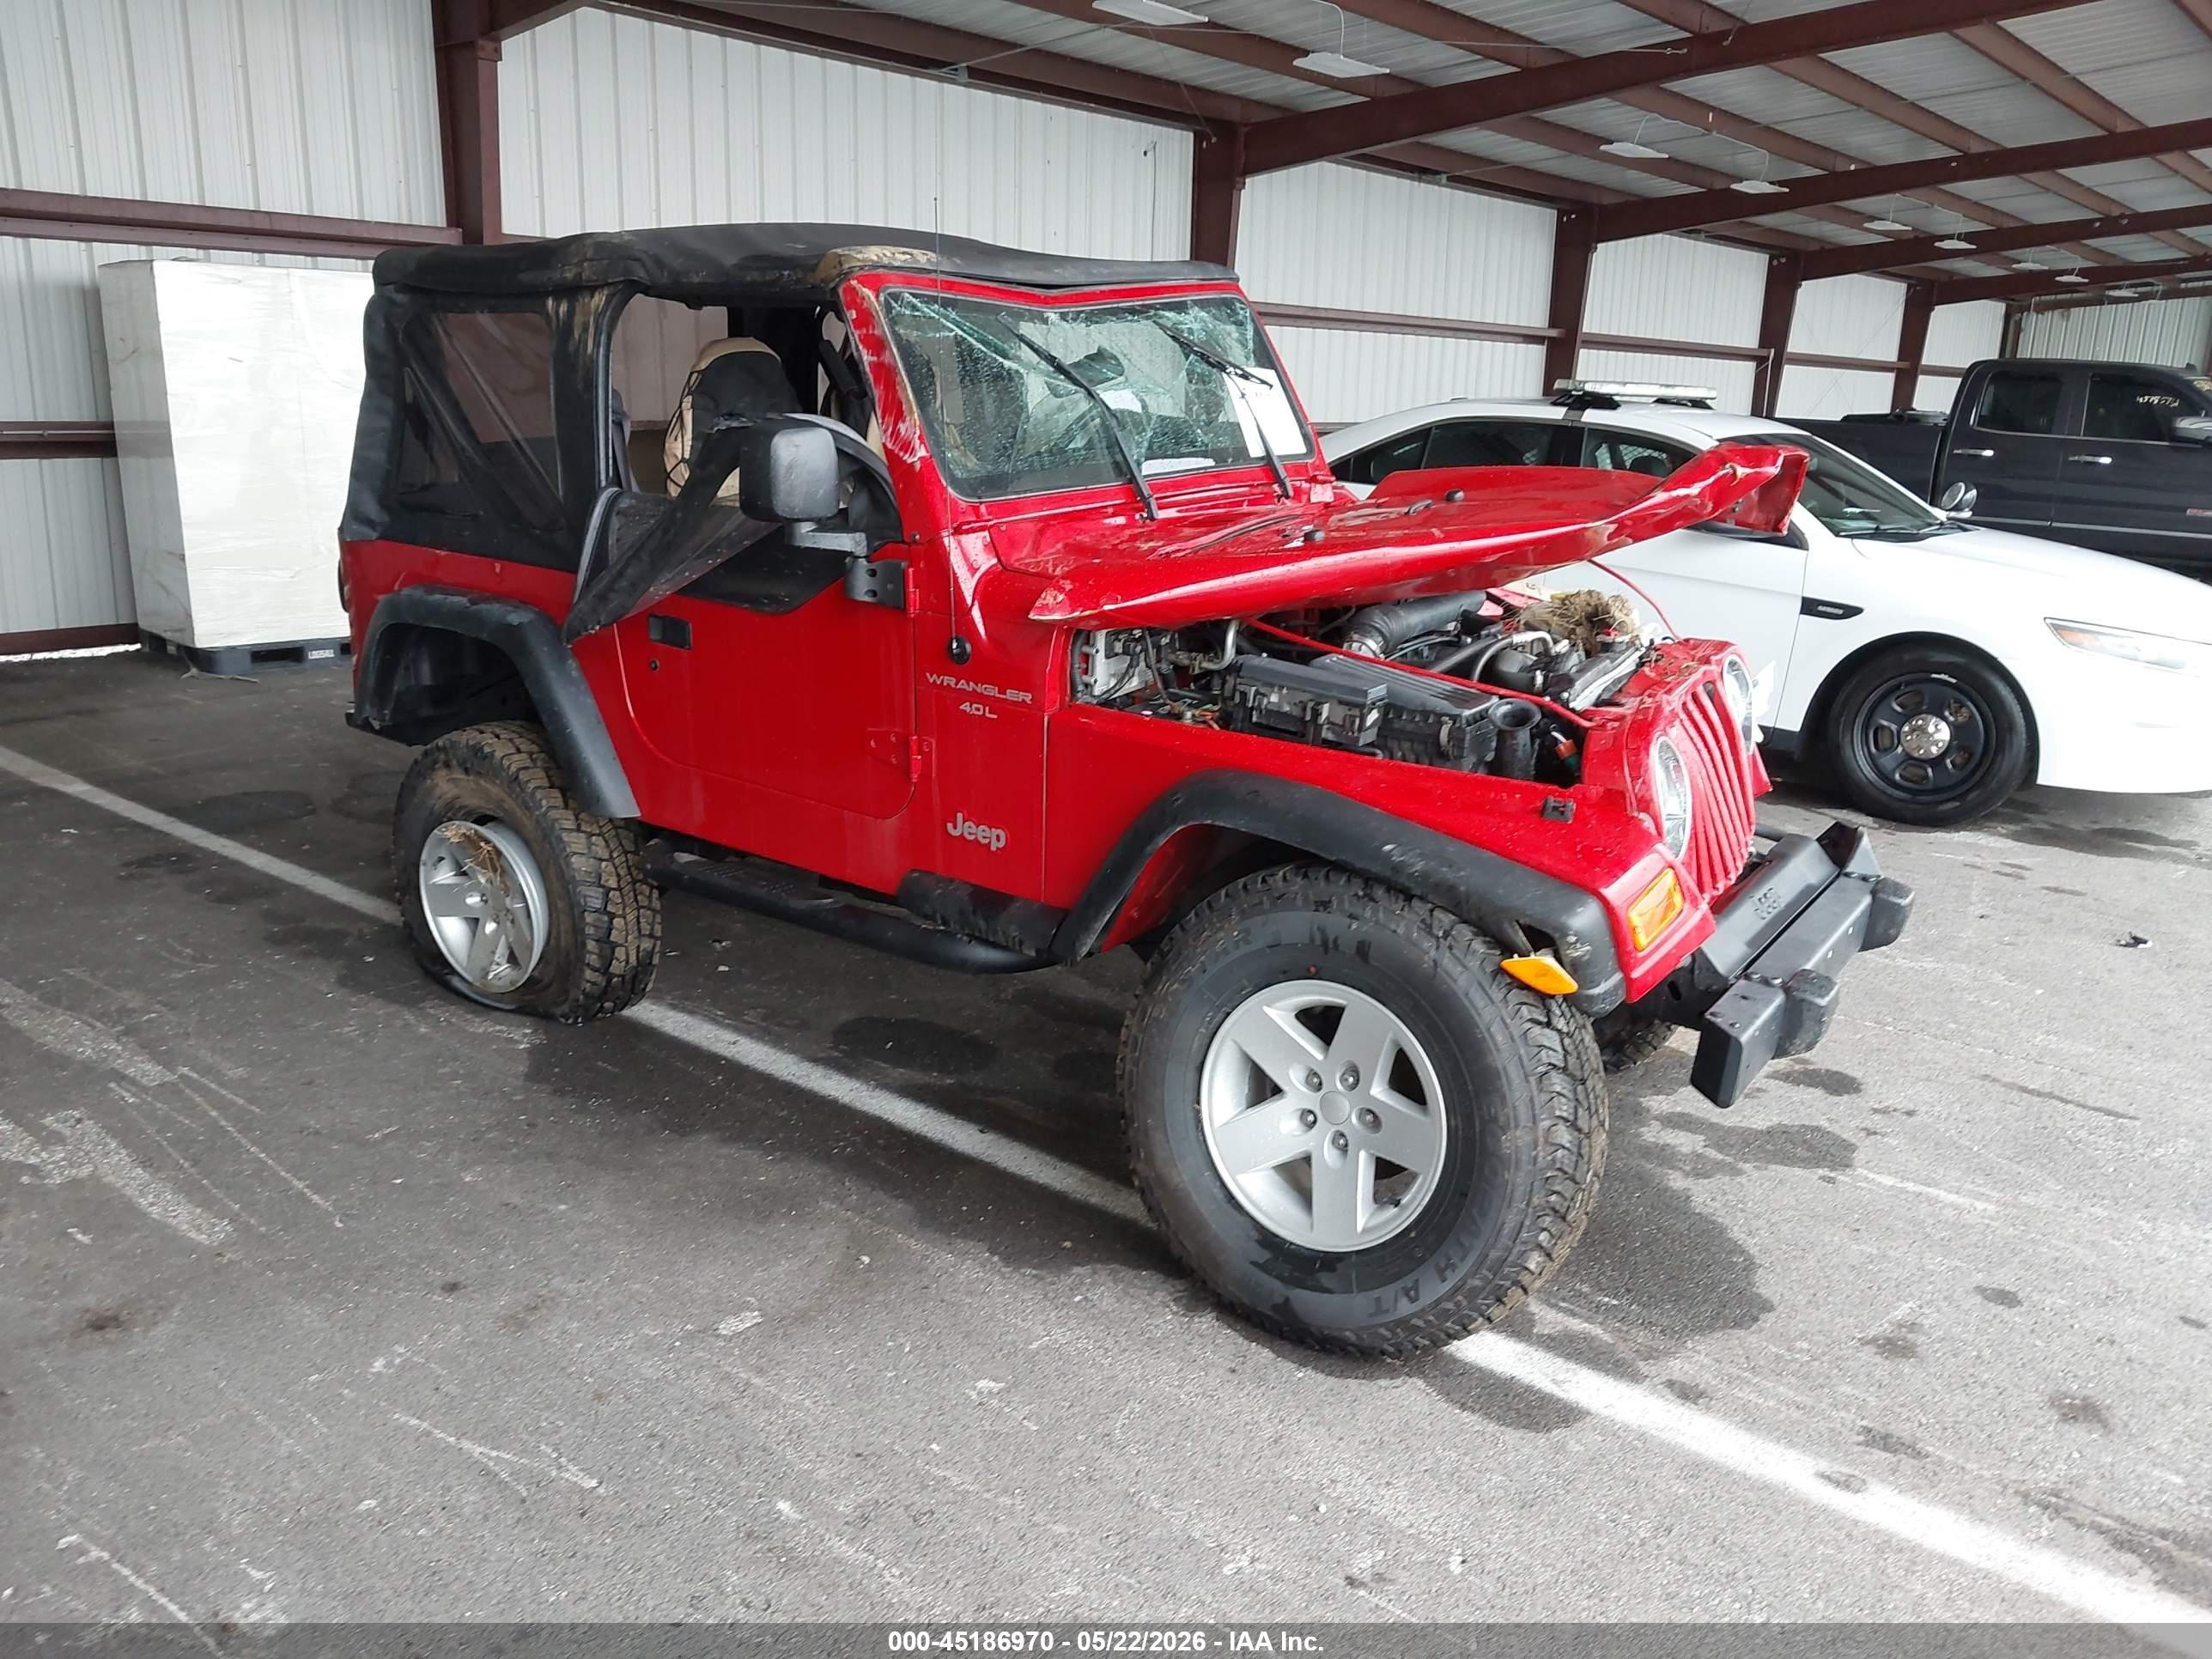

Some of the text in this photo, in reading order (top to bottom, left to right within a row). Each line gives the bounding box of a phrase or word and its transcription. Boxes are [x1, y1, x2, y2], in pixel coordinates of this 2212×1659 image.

[926, 672, 1032, 704] WRANGLER
[946, 812, 1006, 851] Jeep
[1367, 1278, 1421, 1317] A/T
